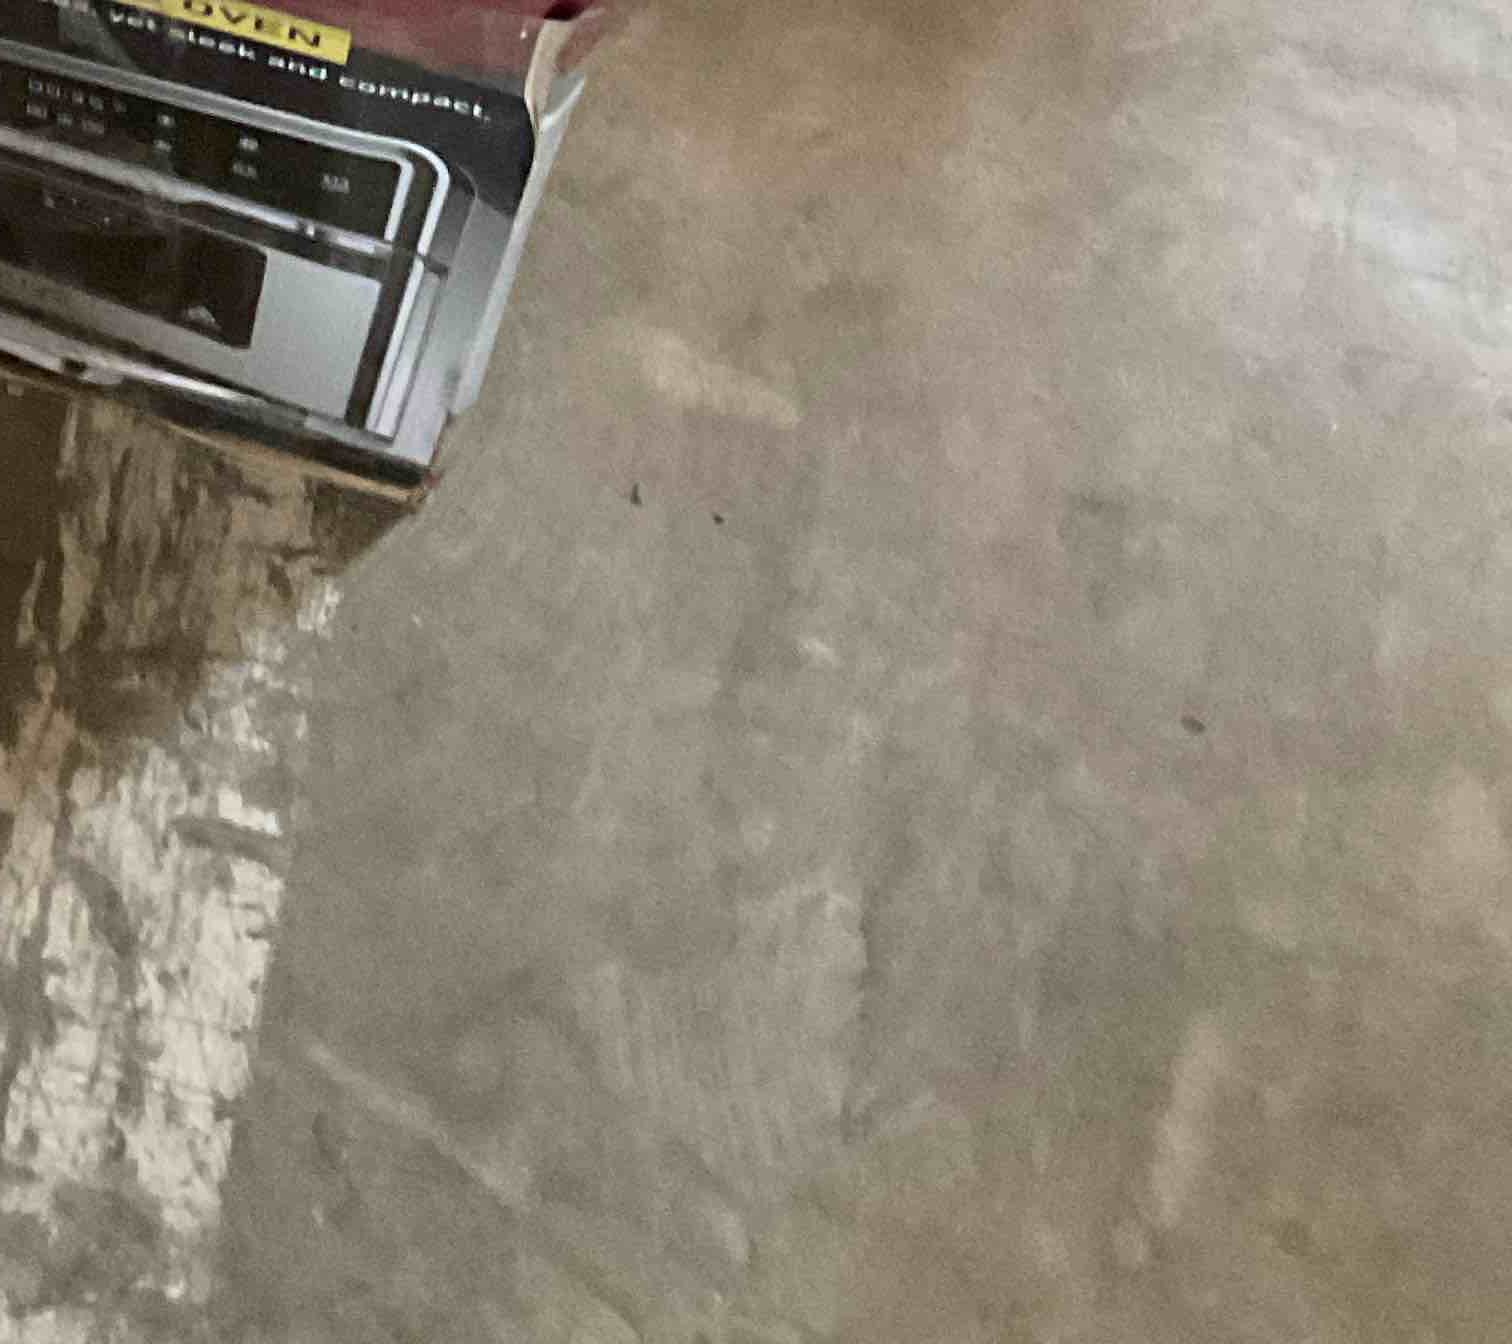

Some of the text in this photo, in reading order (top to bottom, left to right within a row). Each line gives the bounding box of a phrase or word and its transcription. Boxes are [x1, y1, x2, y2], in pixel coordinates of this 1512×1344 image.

[106, 9, 158, 36] yet
[166, 25, 258, 62] sleek
[267, 52, 329, 82] and
